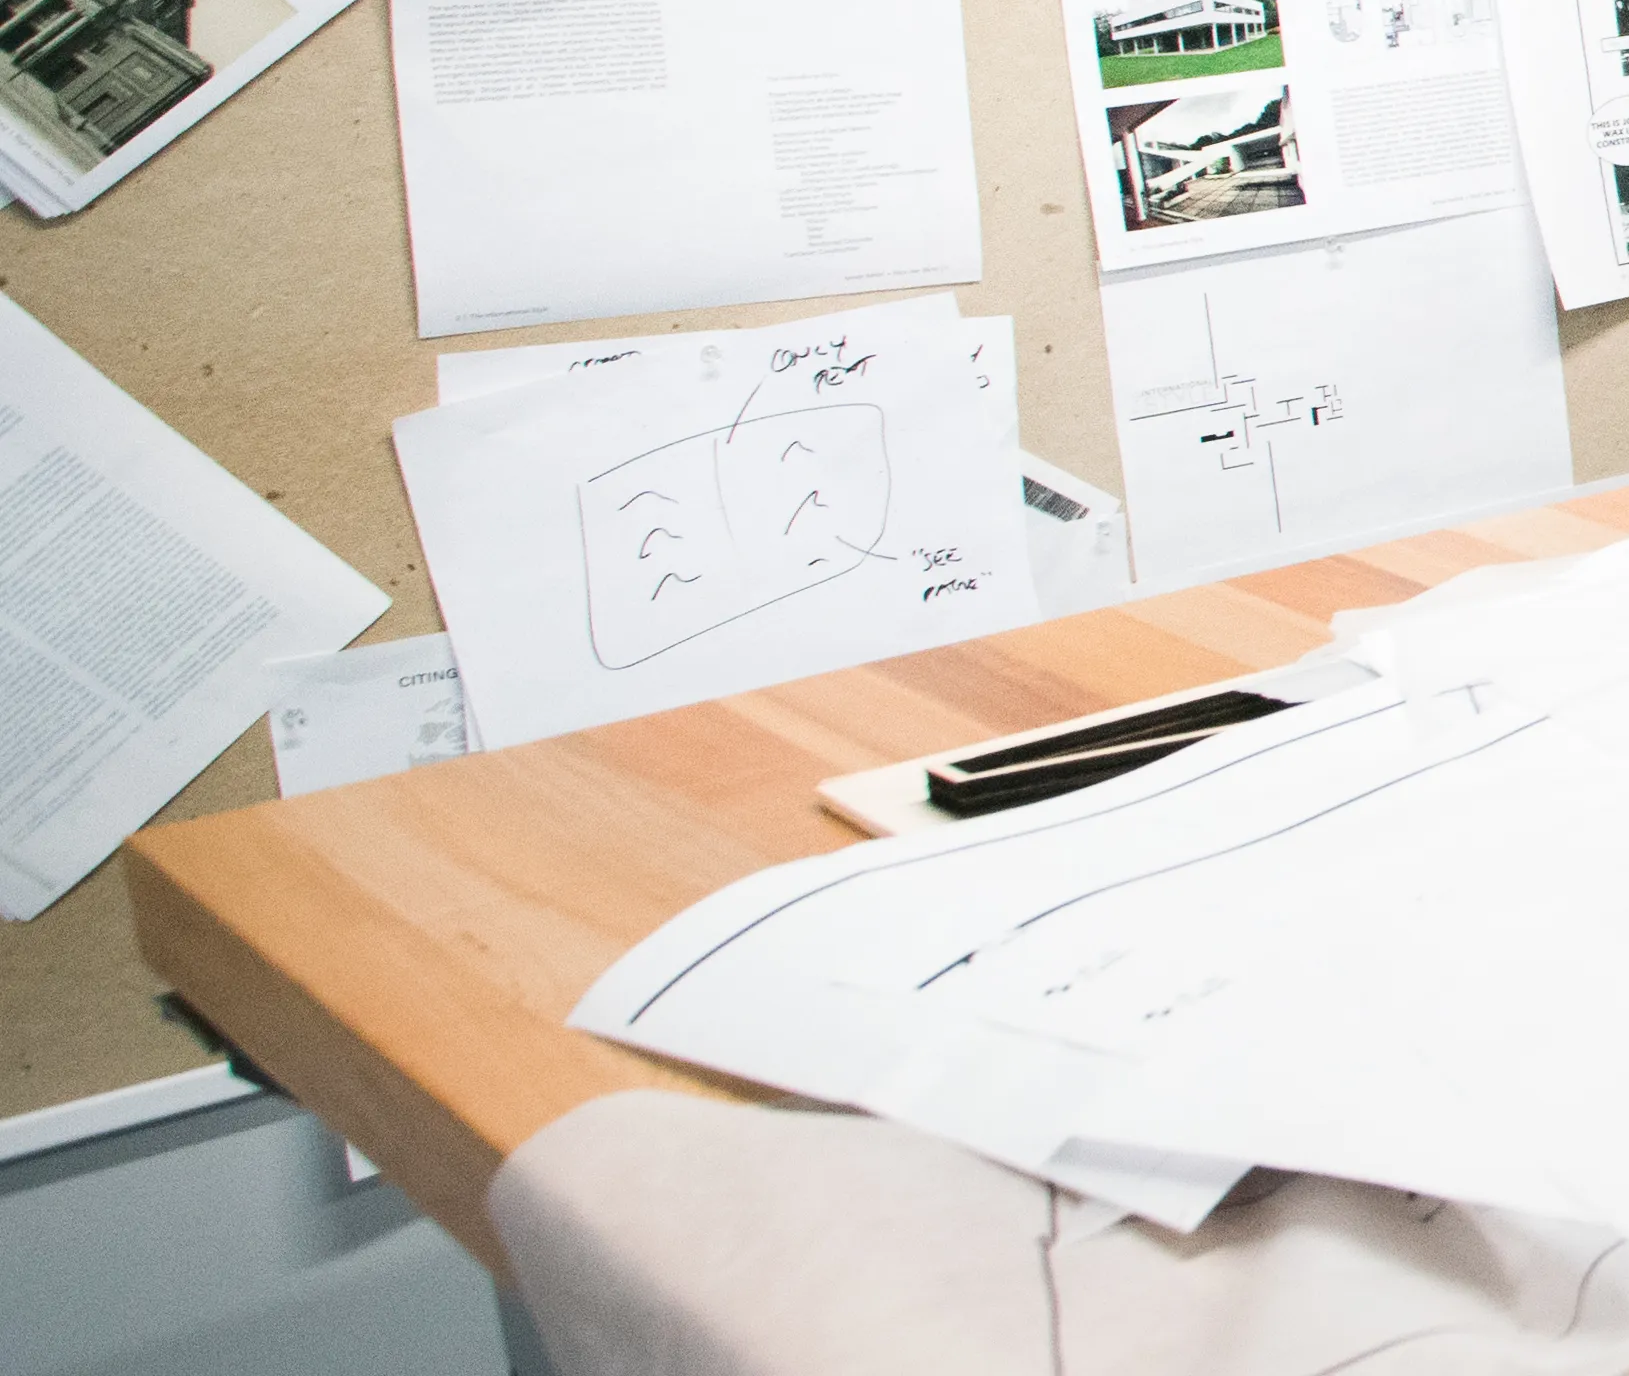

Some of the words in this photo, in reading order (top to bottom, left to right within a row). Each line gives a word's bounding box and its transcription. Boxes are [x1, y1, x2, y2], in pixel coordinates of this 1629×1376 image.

[1591, 121, 1611, 130] THIS
[1603, 128, 1625, 138] WAX
[771, 335, 848, 373] ONLY
[399, 668, 459, 690] CITING
